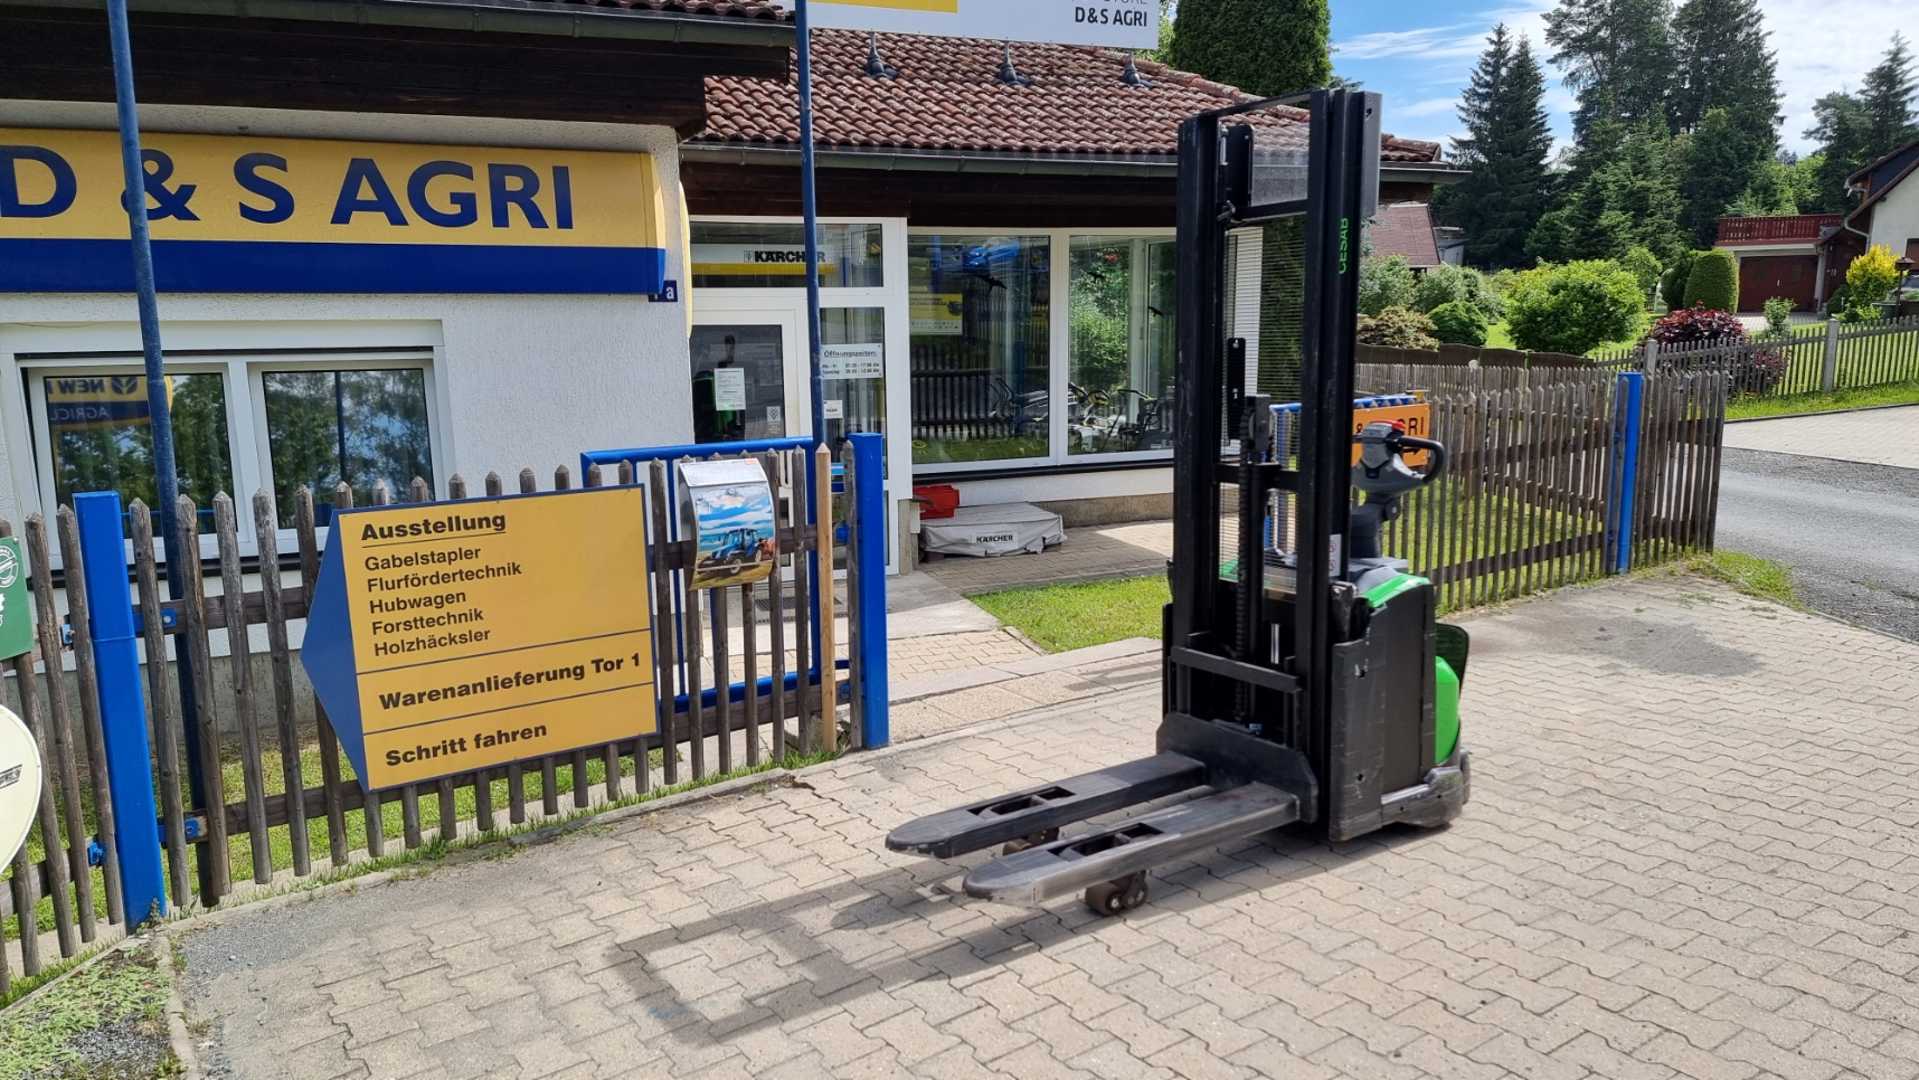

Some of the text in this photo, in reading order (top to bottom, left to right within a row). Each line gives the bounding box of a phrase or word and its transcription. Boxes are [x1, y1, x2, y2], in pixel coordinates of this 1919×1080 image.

[1112, 9, 1147, 27] AGRI
[0, 144, 574, 230] D & S AGRI
[1339, 217, 1349, 274] CESAB
[361, 514, 506, 541] Ausstellung
[364, 547, 481, 571] Gabelstapler
[367, 562, 522, 593] Flurfördertechnik
[369, 591, 466, 614] Hubwagen
[372, 608, 485, 636] Forsttechnik
[374, 629, 491, 657] Holzhäcksler
[379, 652, 641, 710] Warenanlieferung Tor 1
[385, 724, 547, 767] Schritt fahren
